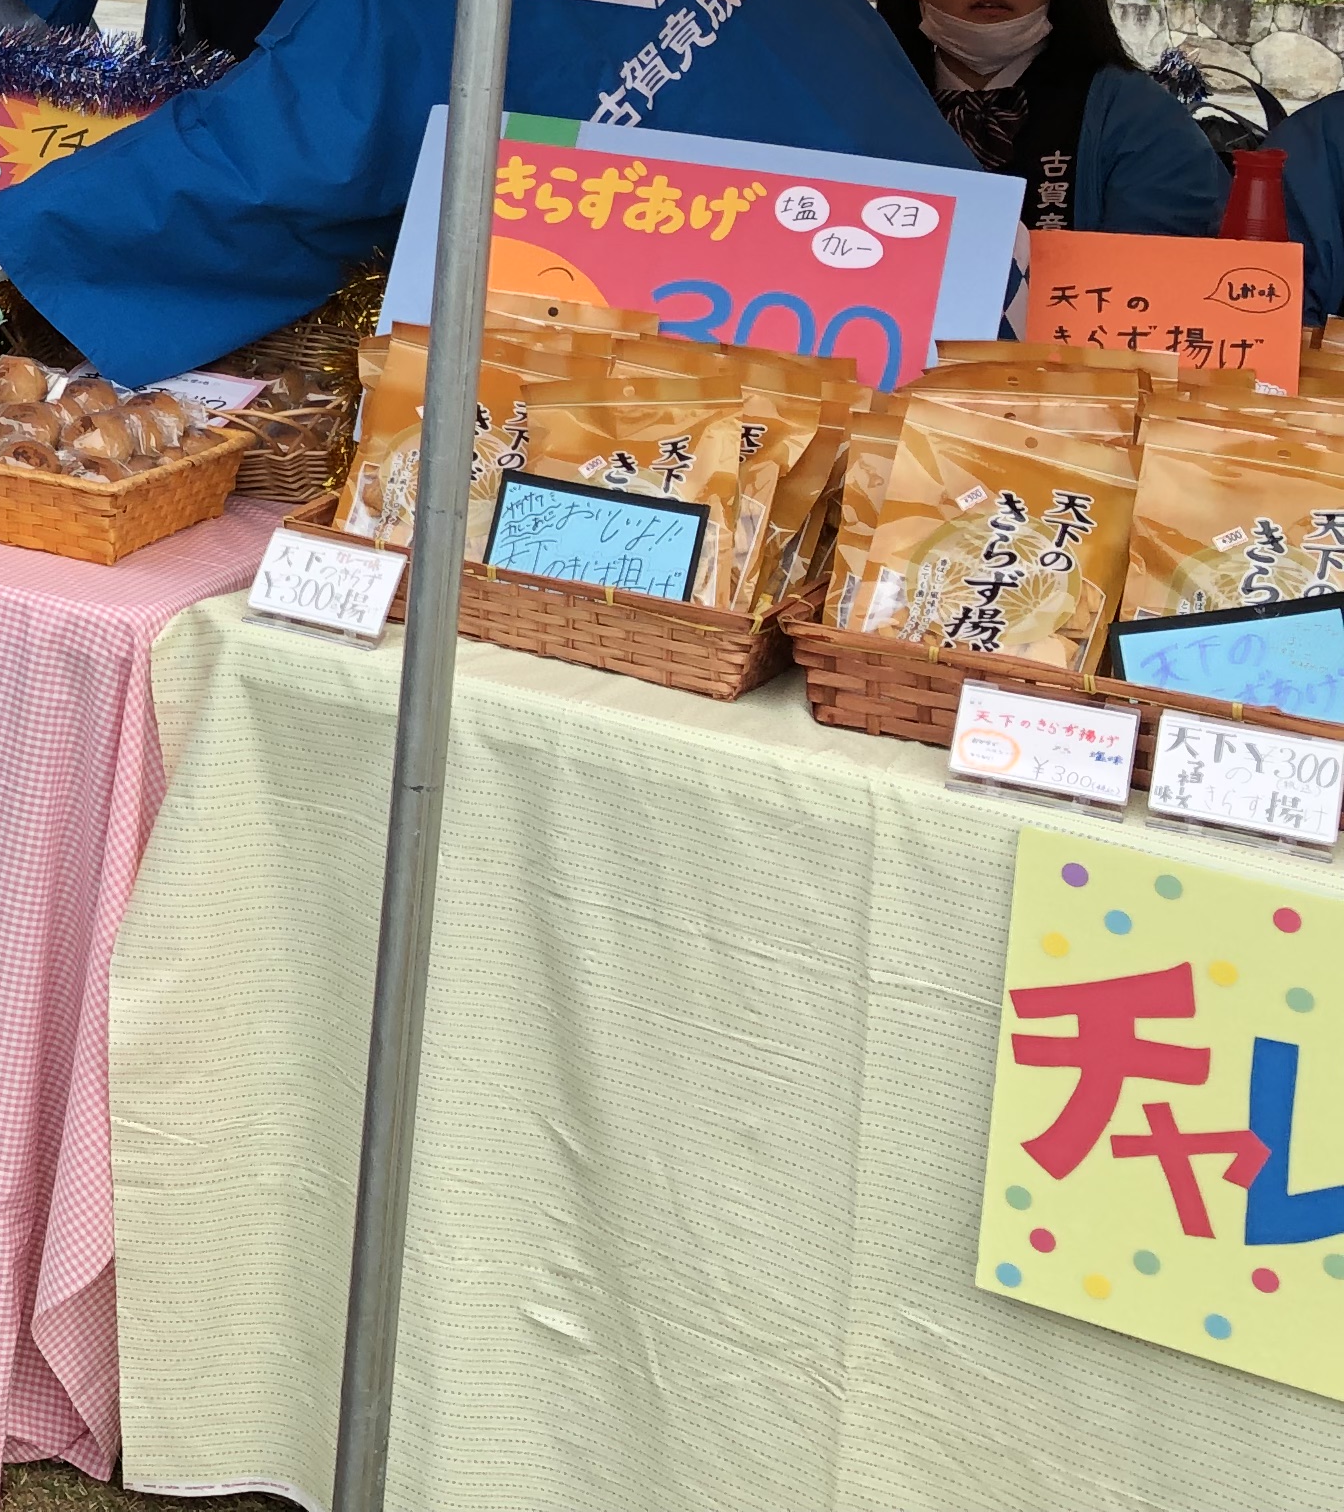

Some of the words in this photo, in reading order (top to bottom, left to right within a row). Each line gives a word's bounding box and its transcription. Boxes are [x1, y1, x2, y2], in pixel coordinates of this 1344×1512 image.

[493, 155, 768, 242] きらずあげ
[781, 196, 819, 222] 塩
[876, 204, 920, 228] マヨ
[820, 233, 874, 257] カレー
[1046, 285, 1150, 314] 天下の
[604, 452, 639, 491] き
[1039, 490, 1096, 573] 天下の
[262, 570, 335, 611] ¥300
[1008, 960, 1344, 1246] チャレ
